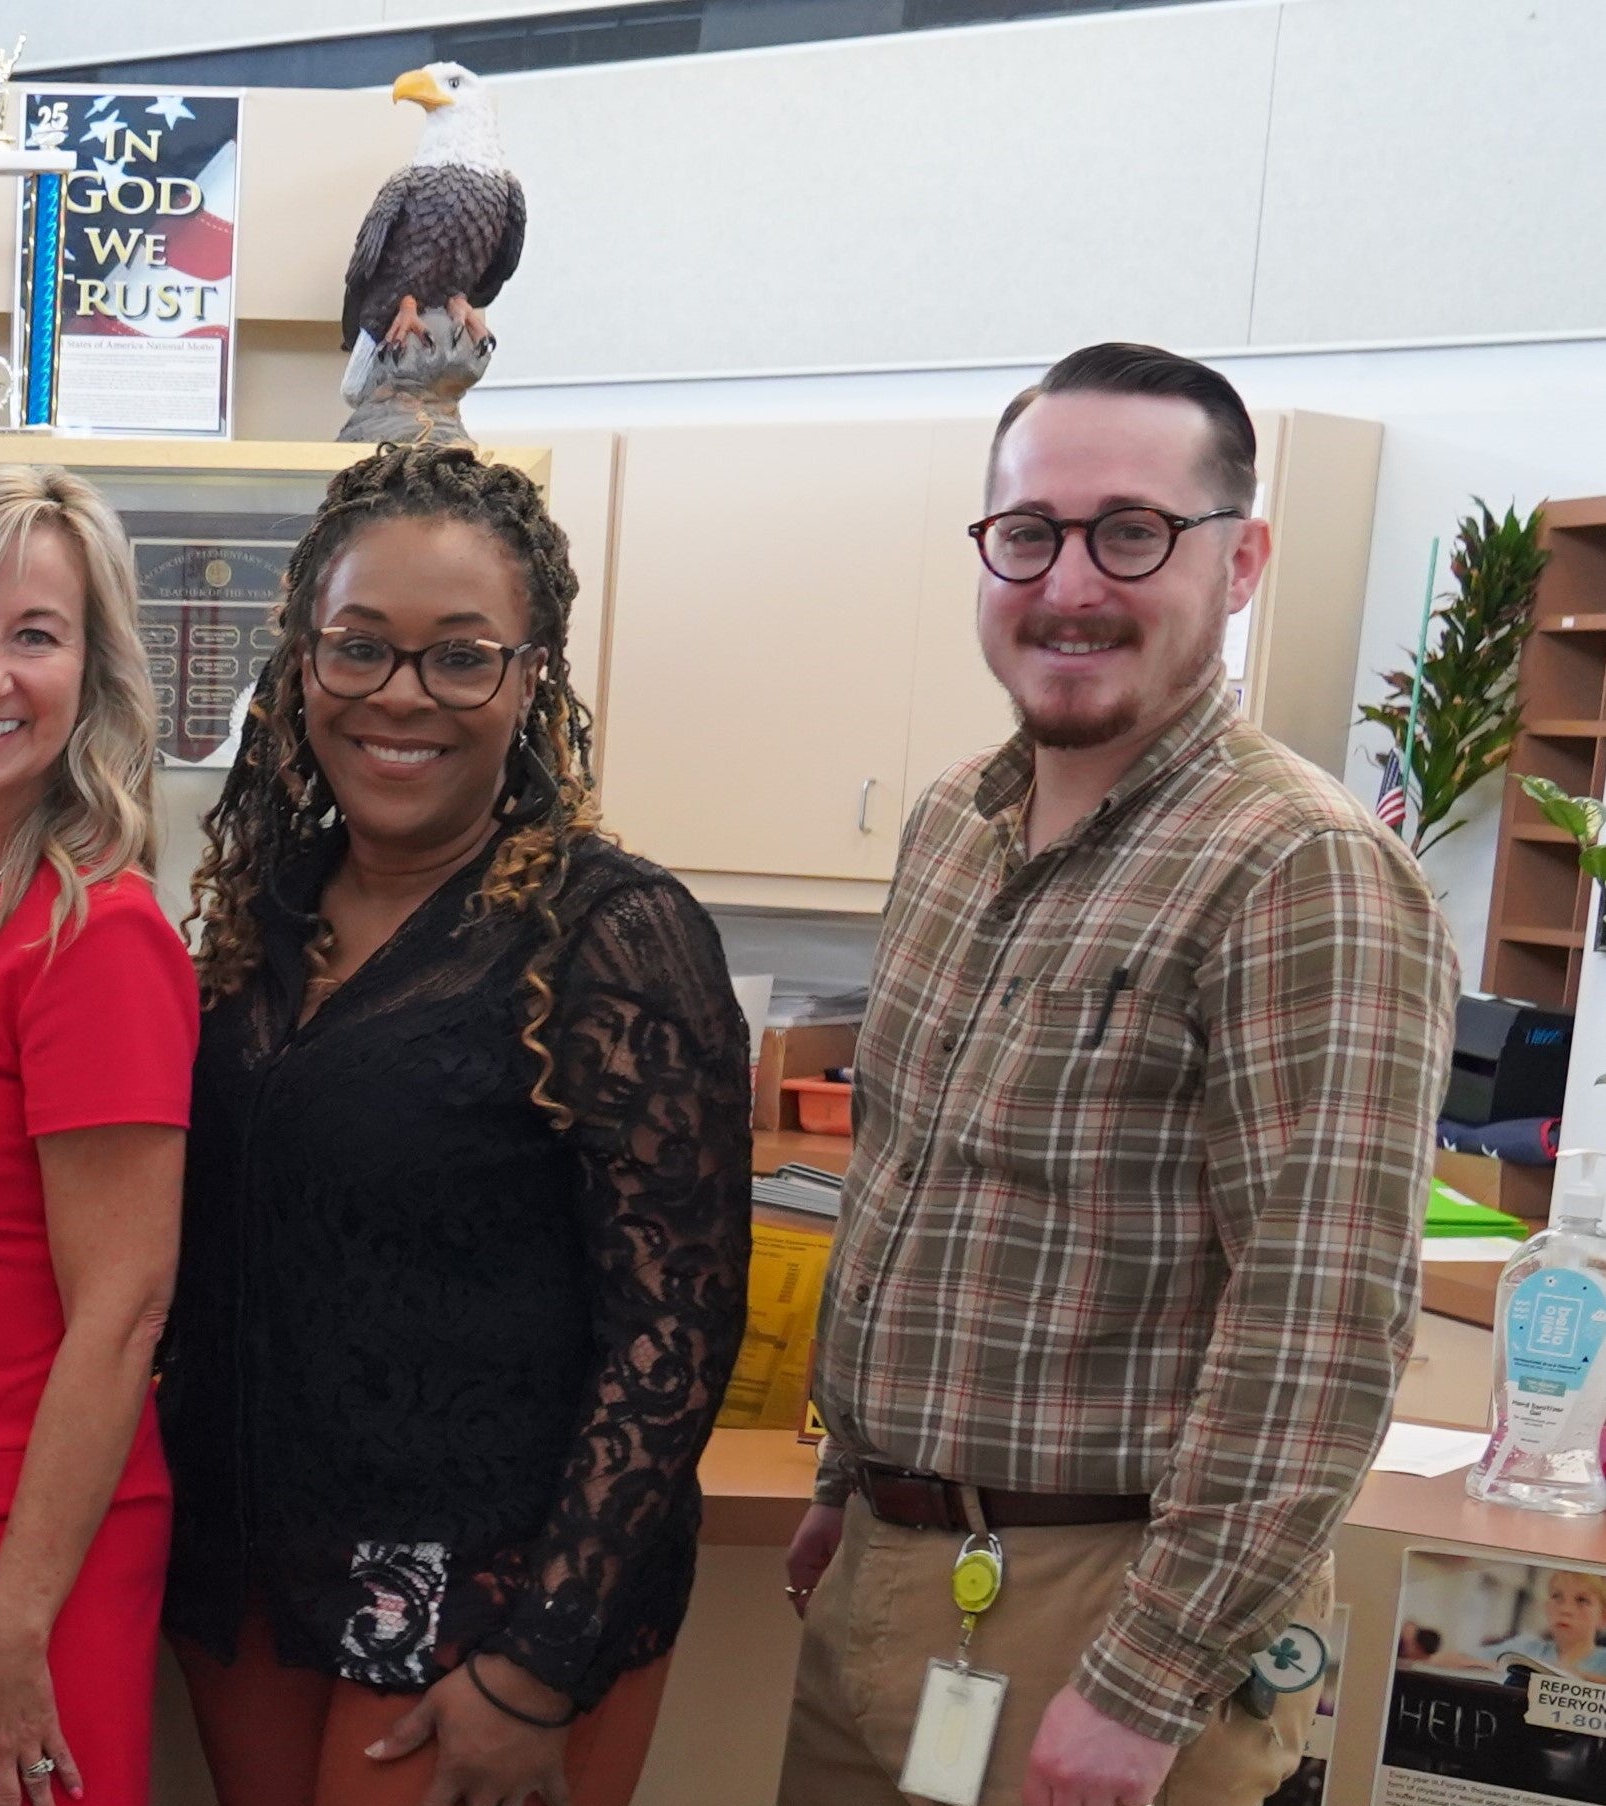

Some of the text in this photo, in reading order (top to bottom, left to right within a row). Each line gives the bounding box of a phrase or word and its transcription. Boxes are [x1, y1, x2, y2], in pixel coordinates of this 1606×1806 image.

[39, 102, 69, 128] 25
[104, 129, 162, 163] IN
[66, 170, 203, 215] GOD
[84, 228, 167, 266] WE
[1399, 1695, 1498, 1750] HELP
